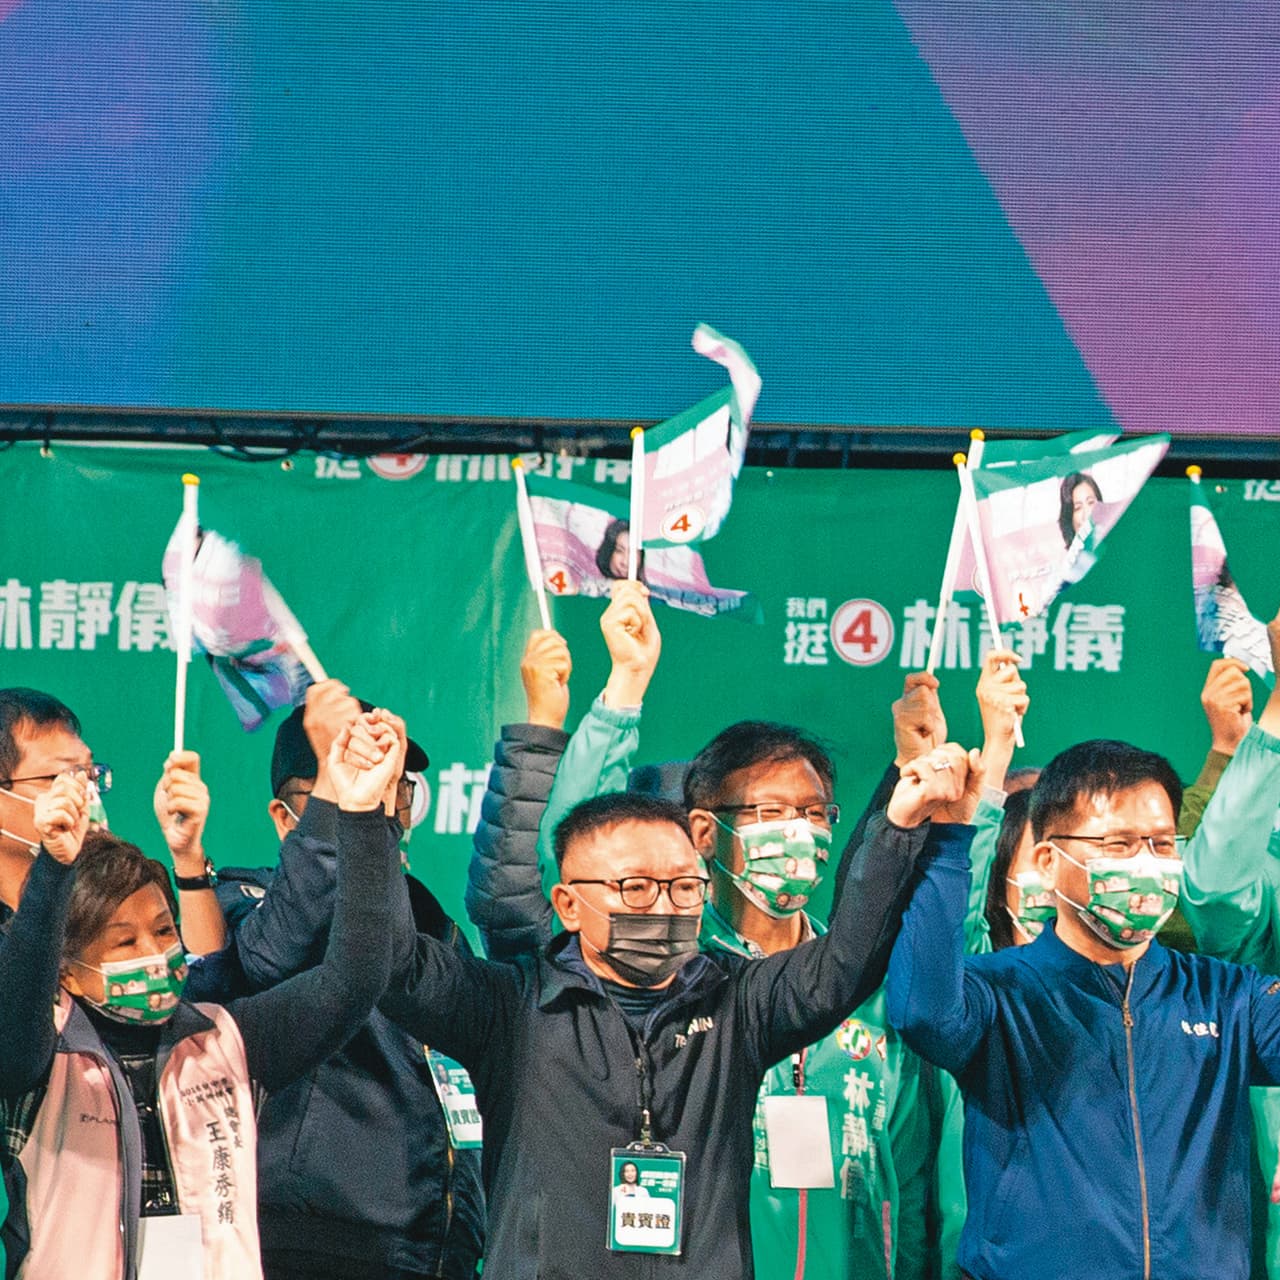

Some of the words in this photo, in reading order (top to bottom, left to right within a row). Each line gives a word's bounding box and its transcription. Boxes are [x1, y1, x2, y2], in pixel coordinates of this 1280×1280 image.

[670, 514, 692, 533] 4
[549, 570, 568, 593] 4
[784, 622, 829, 665] 挺
[841, 609, 879, 653] 4
[621, 1211, 671, 1229] 貴賓證
